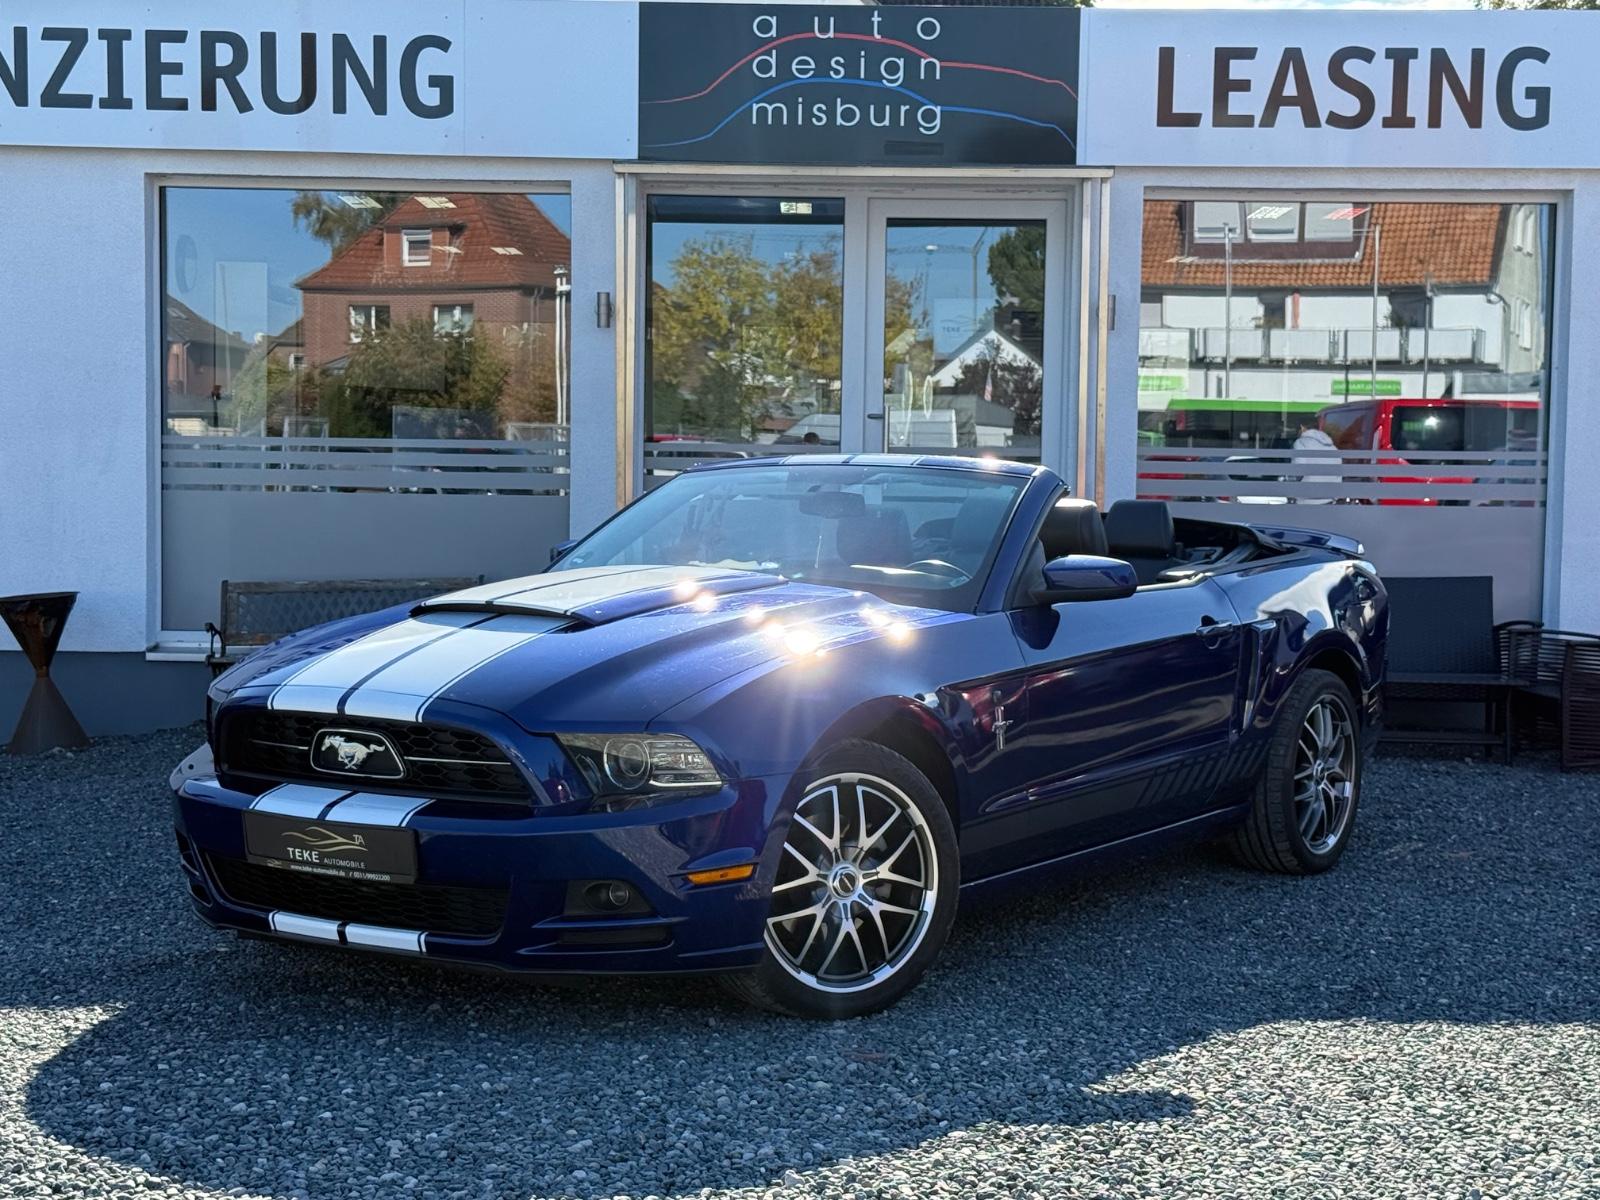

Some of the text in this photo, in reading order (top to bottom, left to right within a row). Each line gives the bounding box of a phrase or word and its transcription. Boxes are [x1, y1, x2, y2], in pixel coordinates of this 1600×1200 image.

[752, 10, 941, 40] auto
[752, 49, 941, 87] design
[1156, 45, 1552, 132] LEASING
[751, 97, 942, 135] misburg
[287, 847, 366, 869] TEKE AUTOMOBILE
